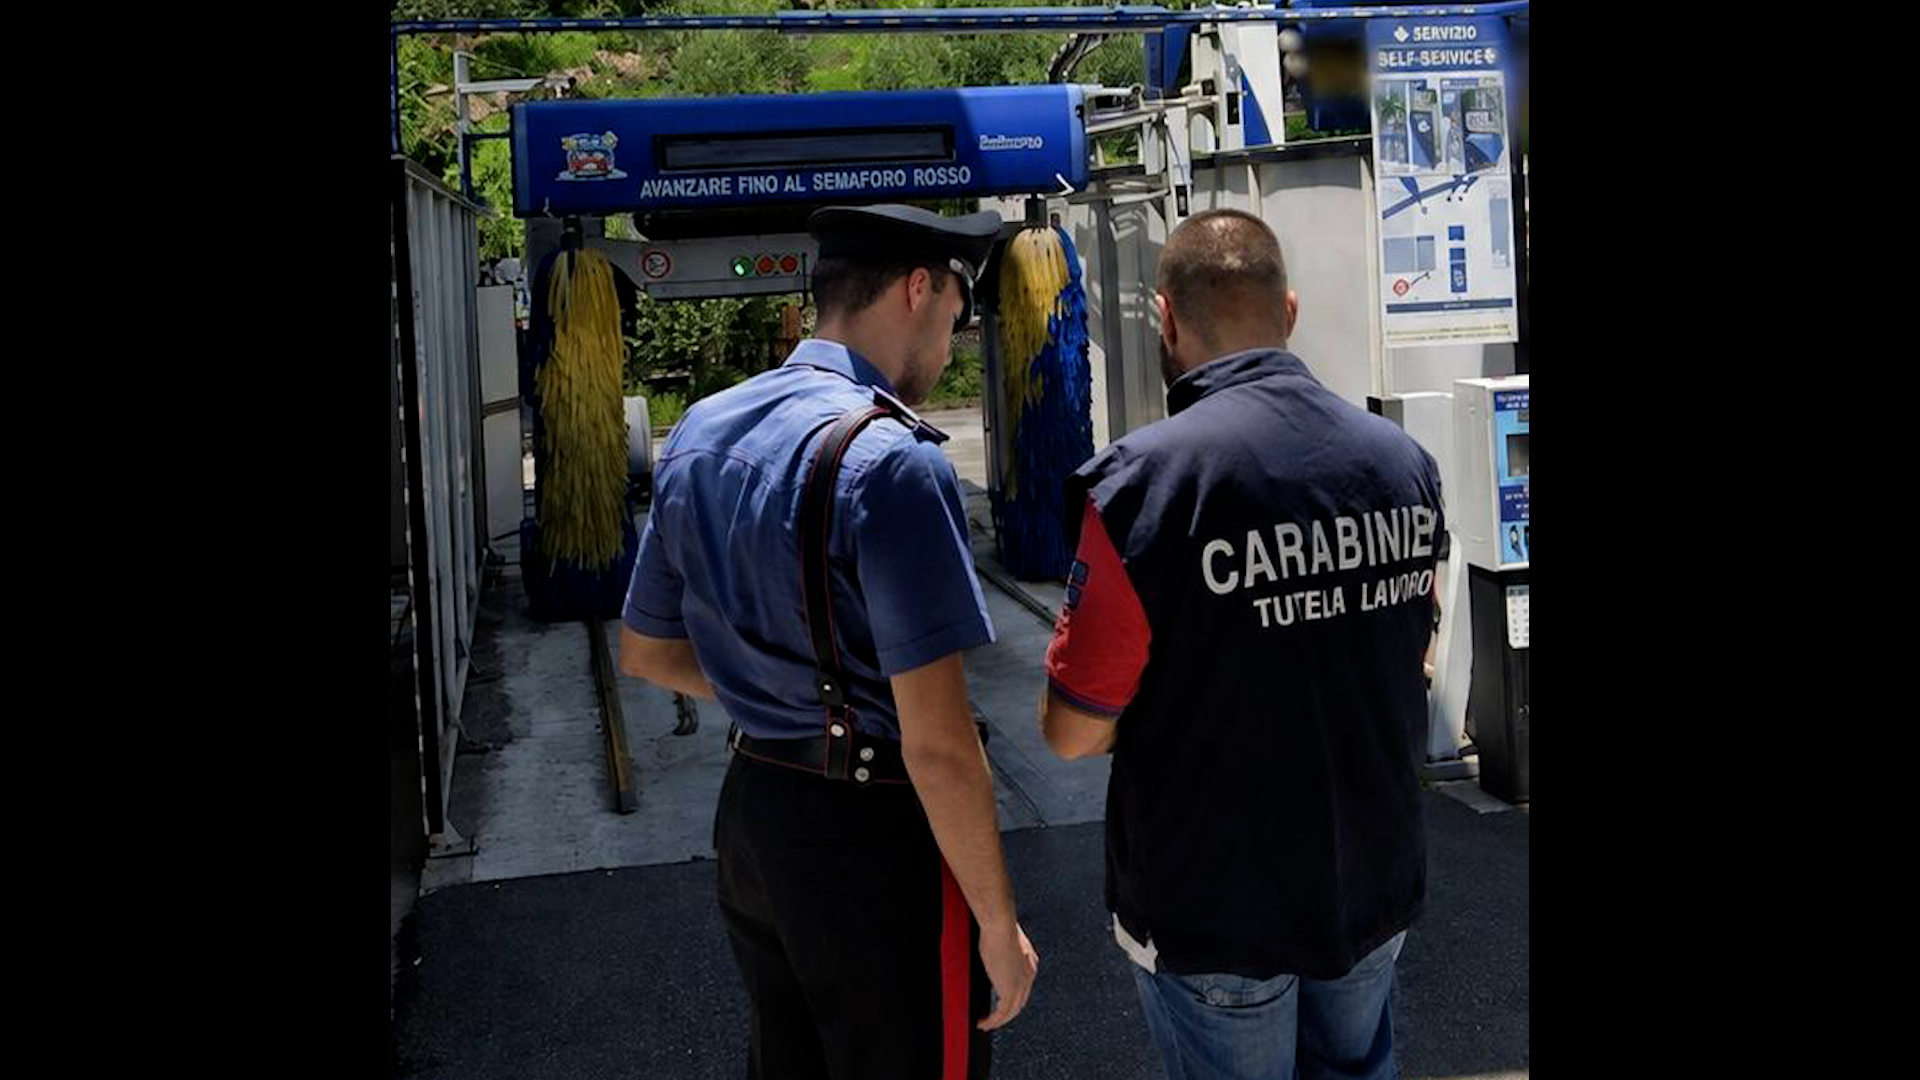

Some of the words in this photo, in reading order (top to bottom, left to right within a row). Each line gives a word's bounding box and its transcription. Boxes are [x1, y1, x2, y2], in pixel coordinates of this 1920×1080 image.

[1413, 25, 1477, 42] SERVIZIO
[640, 177, 732, 199] AVANZARE
[738, 175, 778, 194] FINO
[784, 174, 806, 192] AL
[813, 169, 906, 191] SEMAFORO
[914, 166, 971, 186] ROSSO
[1202, 504, 1437, 595] CARABINIE
[1253, 586, 1346, 628] TUTELA
[1361, 568, 1434, 611] LAVORO
